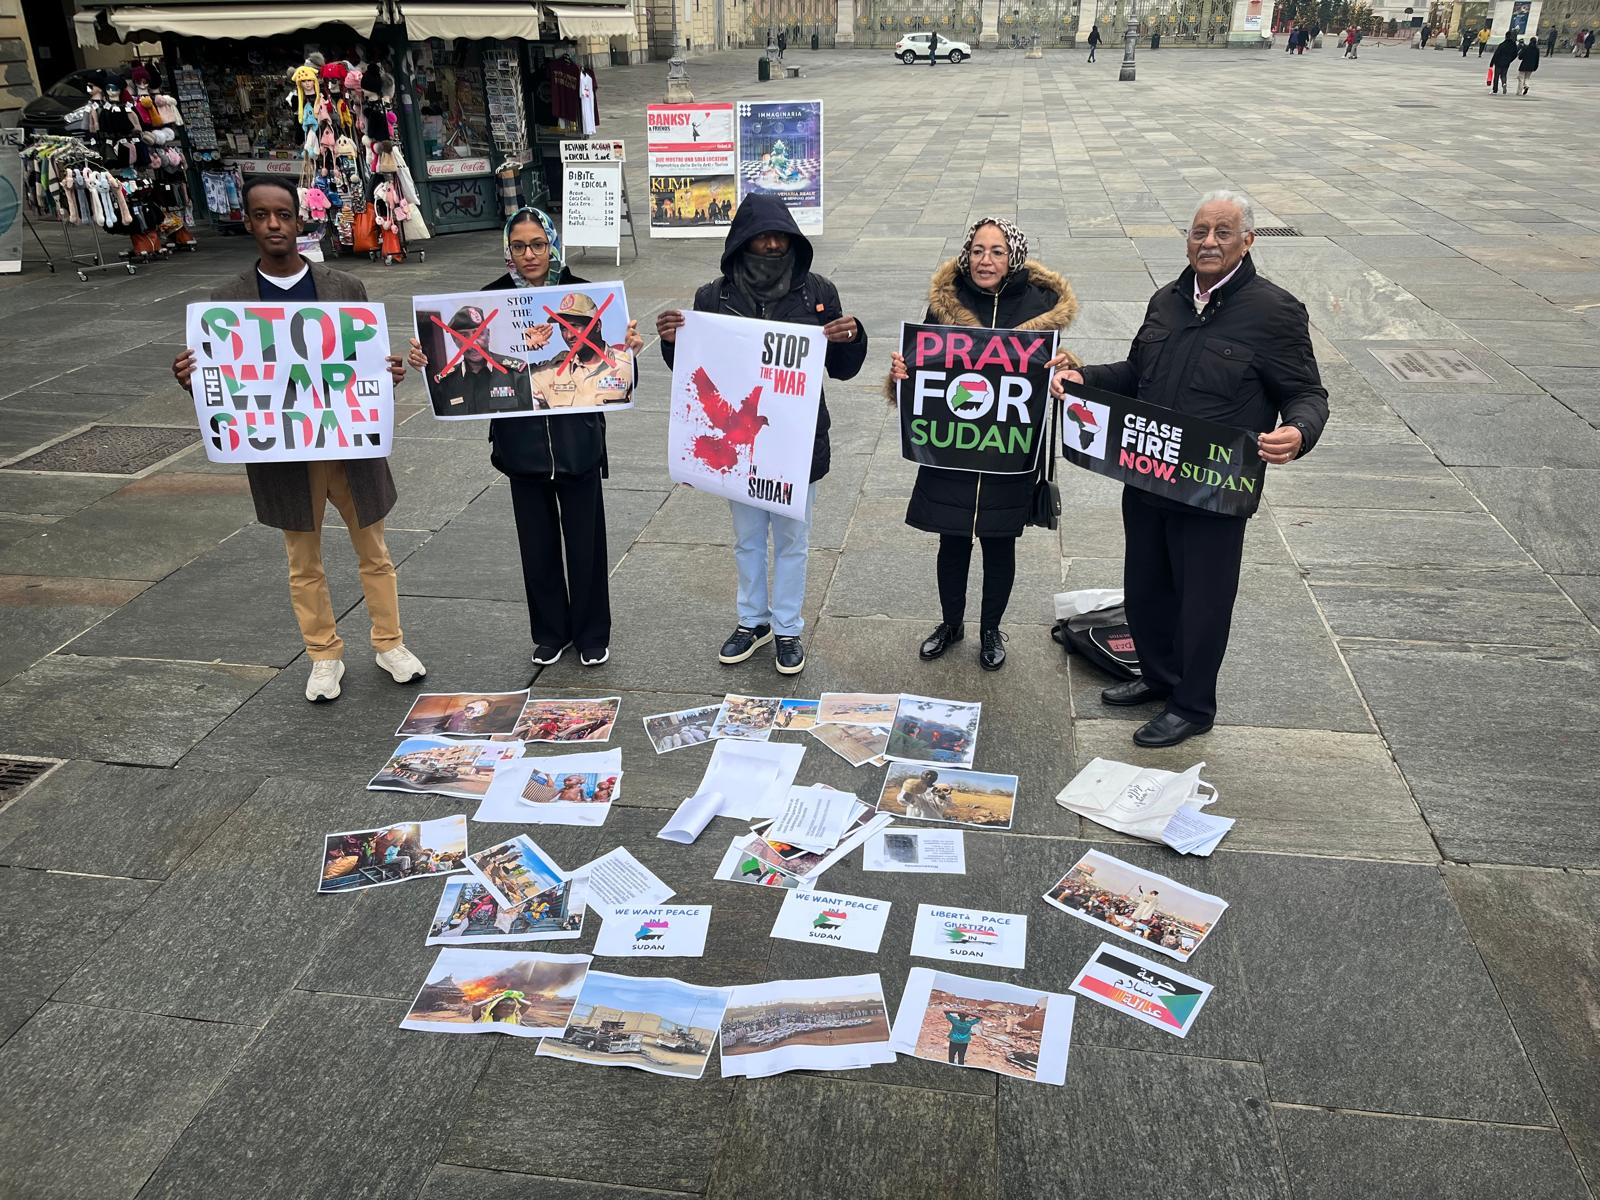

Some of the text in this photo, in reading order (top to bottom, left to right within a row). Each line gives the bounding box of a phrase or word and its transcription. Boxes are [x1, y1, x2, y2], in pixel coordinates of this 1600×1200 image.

[648, 114, 690, 126] BANKSY
[507, 296, 534, 306] STOP
[511, 309, 533, 317] THE
[512, 320, 535, 329] WAR
[200, 307, 378, 362] STOP
[521, 332, 532, 341] IN
[510, 344, 544, 353] SUDAN
[761, 331, 810, 369] STOP
[915, 331, 1045, 373] PRAY
[204, 363, 378, 410] THE WAR IN
[760, 367, 806, 397] THE WAR
[913, 370, 1032, 423] FOR
[209, 409, 381, 451] SUDAN
[911, 418, 1033, 454] SUDAN
[1124, 413, 1183, 443] CEASE
[1120, 427, 1181, 464] FIRE
[1207, 443, 1232, 464] IN
[750, 464, 756, 476] IN
[1118, 448, 1176, 484] NOW.
[1180, 462, 1256, 494] SUDAN
[748, 476, 793, 505] SUDAN
[812, 896, 843, 905] WANT
[845, 901, 879, 911] PEACE
[944, 922, 994, 932] GIUSTIZIA
[982, 916, 1011, 925] PACE
[809, 931, 841, 940] SUDAN
[950, 949, 984, 957] SUDAN
[1113, 978, 1153, 997] سلام
[1137, 967, 1176, 992] حرية
